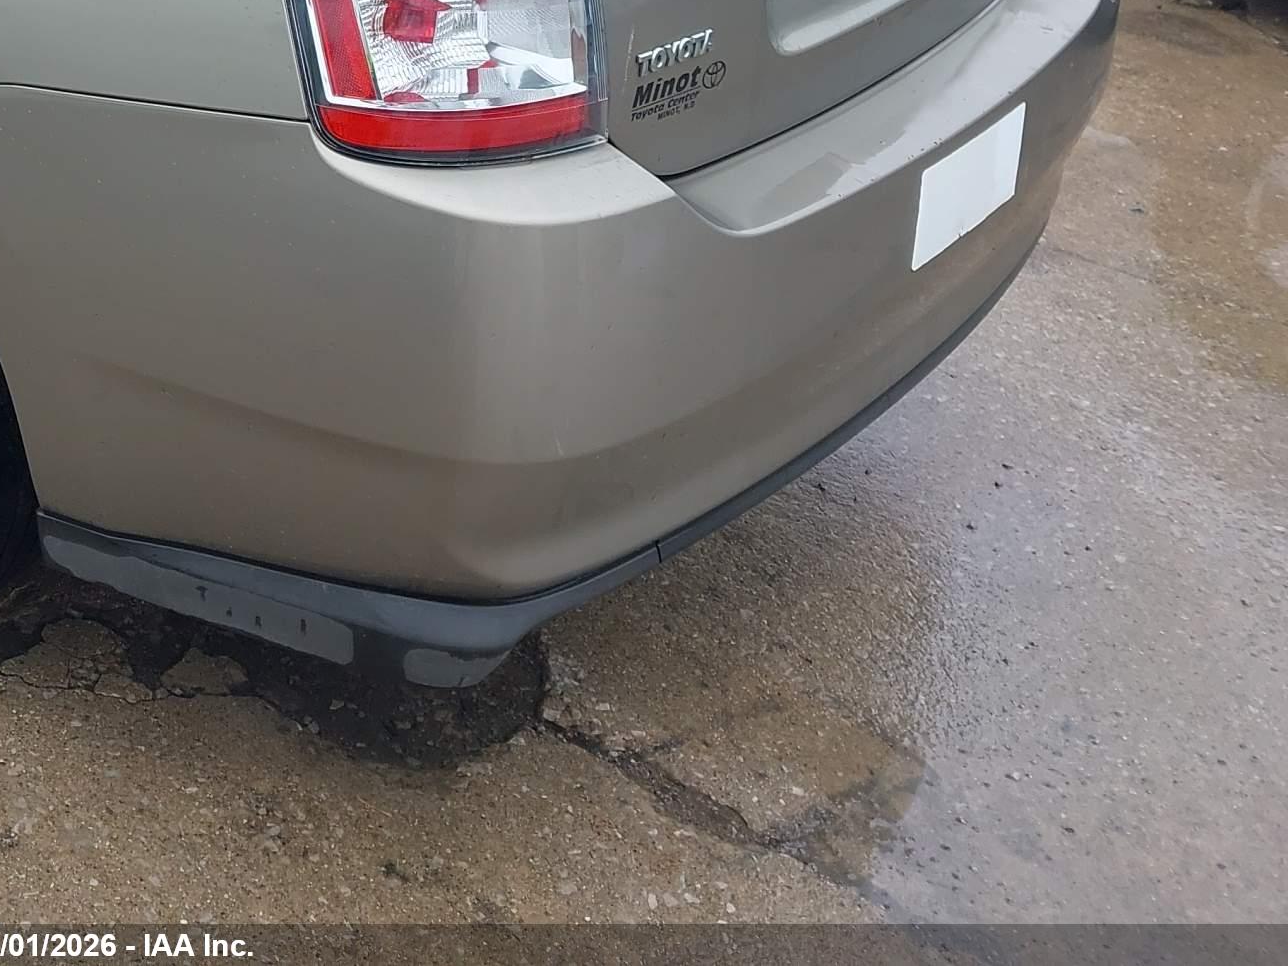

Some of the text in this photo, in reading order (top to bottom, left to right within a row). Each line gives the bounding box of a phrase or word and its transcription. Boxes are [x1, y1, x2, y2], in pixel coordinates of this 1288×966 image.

[636, 28, 714, 78] TOYOTA
[631, 65, 702, 109] Minot
[631, 90, 700, 122] Toyota Center
